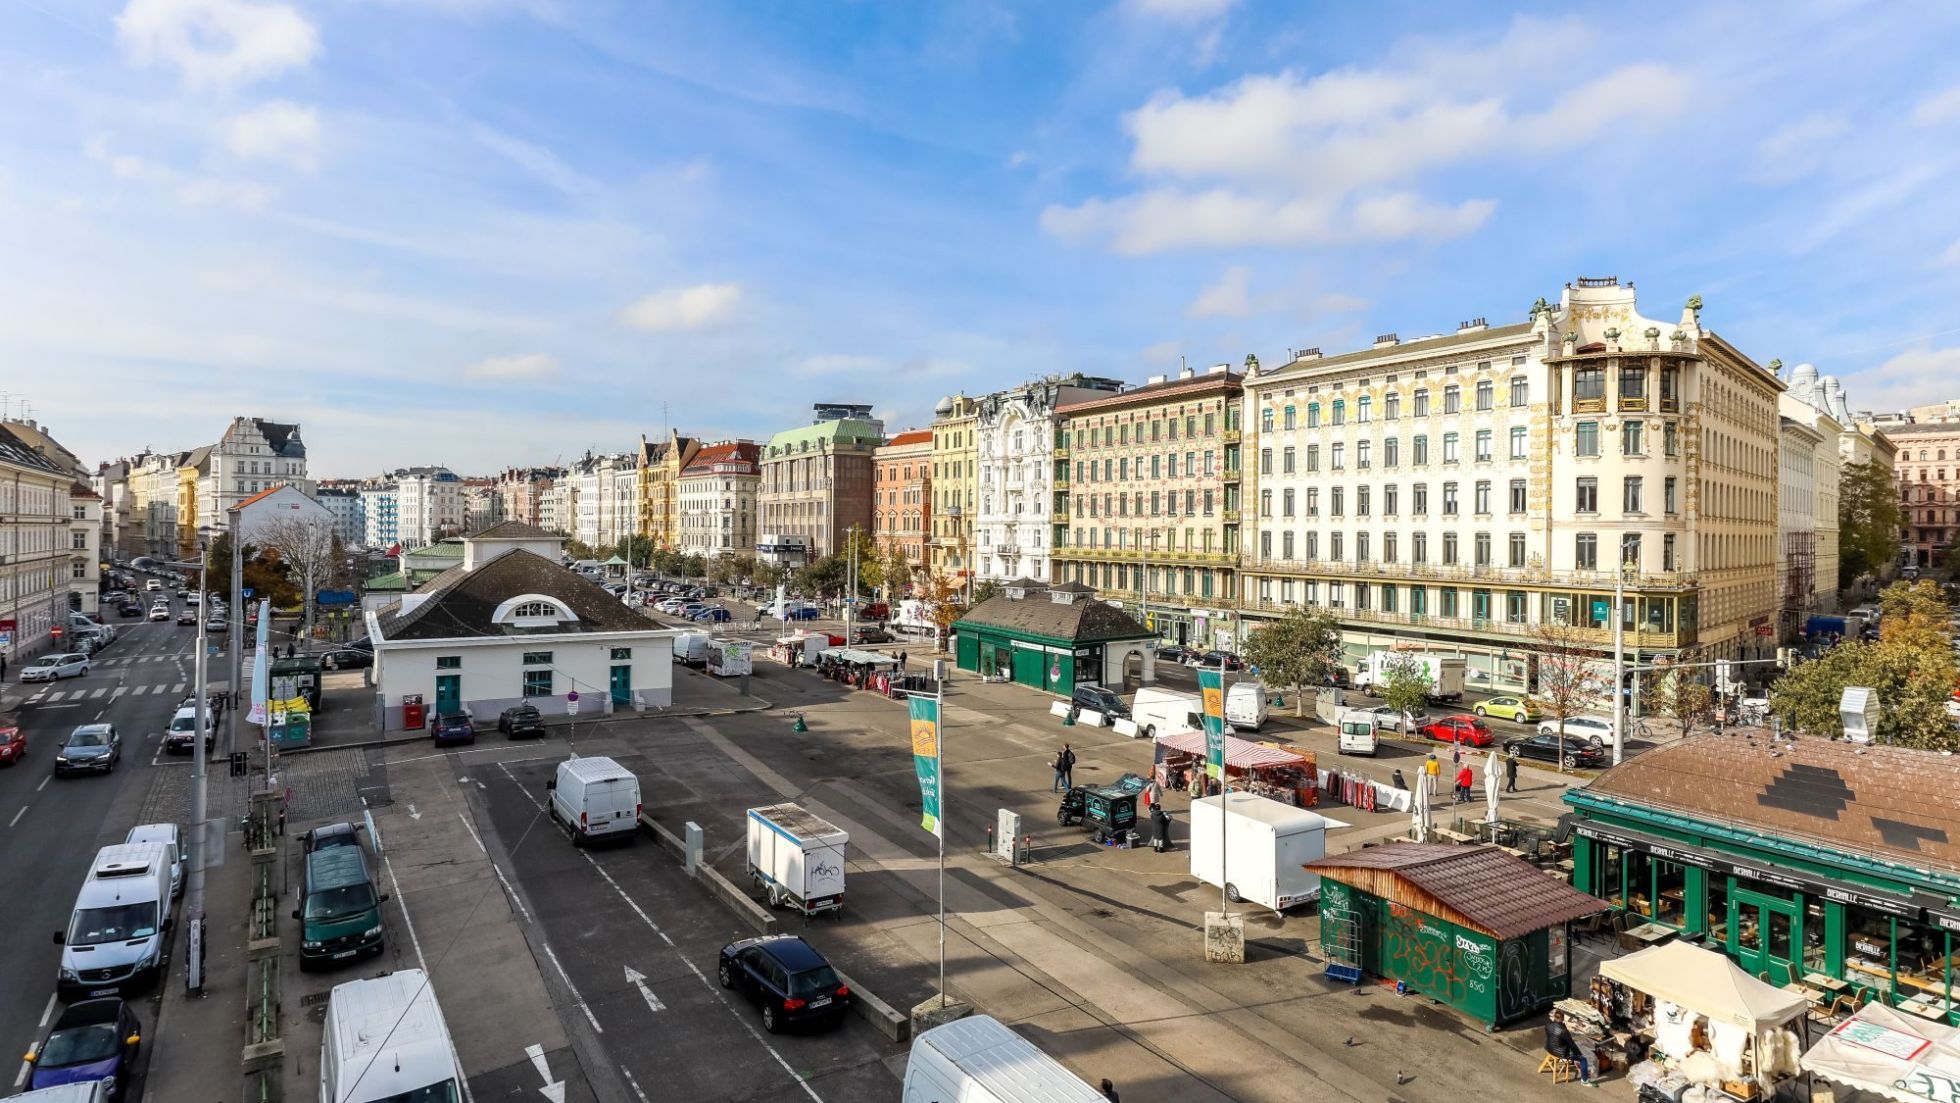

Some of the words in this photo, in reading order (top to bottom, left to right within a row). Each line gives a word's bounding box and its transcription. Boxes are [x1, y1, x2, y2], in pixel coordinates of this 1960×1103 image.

[1576, 827, 1599, 839] BIERHALLE
[1650, 845, 1675, 859] BIERHALLE
[1733, 865, 1760, 880] BIERHALLE
[1826, 888, 1858, 904] BIERHALLE
